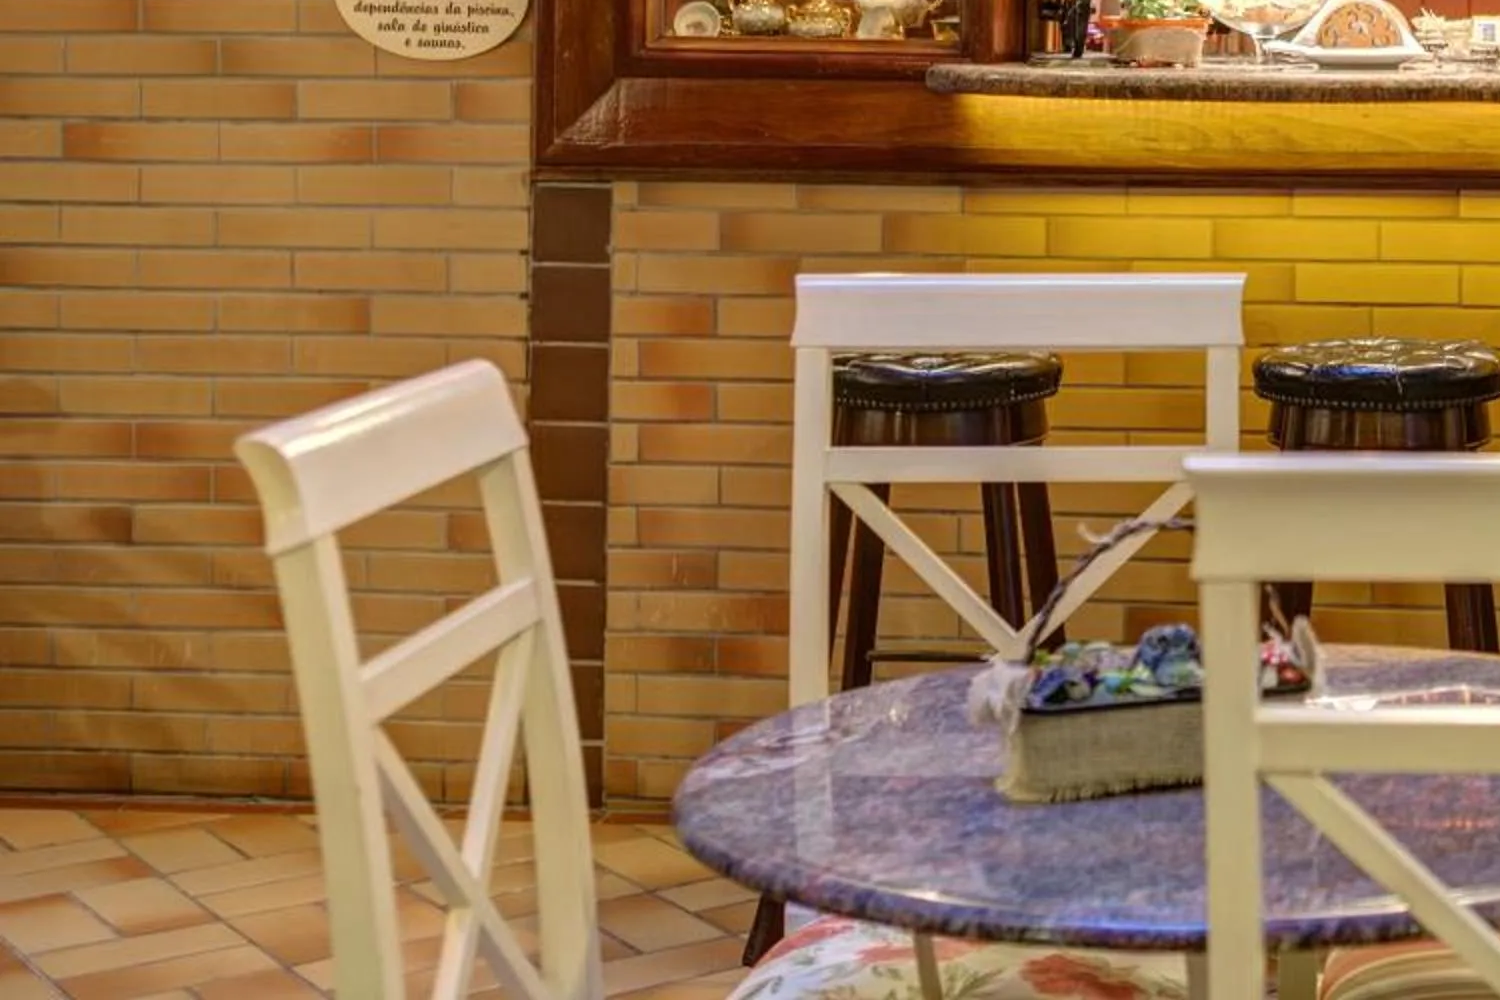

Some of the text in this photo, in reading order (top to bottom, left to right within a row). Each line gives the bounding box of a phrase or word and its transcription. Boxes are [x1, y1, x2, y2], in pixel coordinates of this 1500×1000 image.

[445, 2, 461, 15] da
[377, 18, 405, 32] sala
[412, 19, 428, 32] de
[404, 38, 412, 48] e
